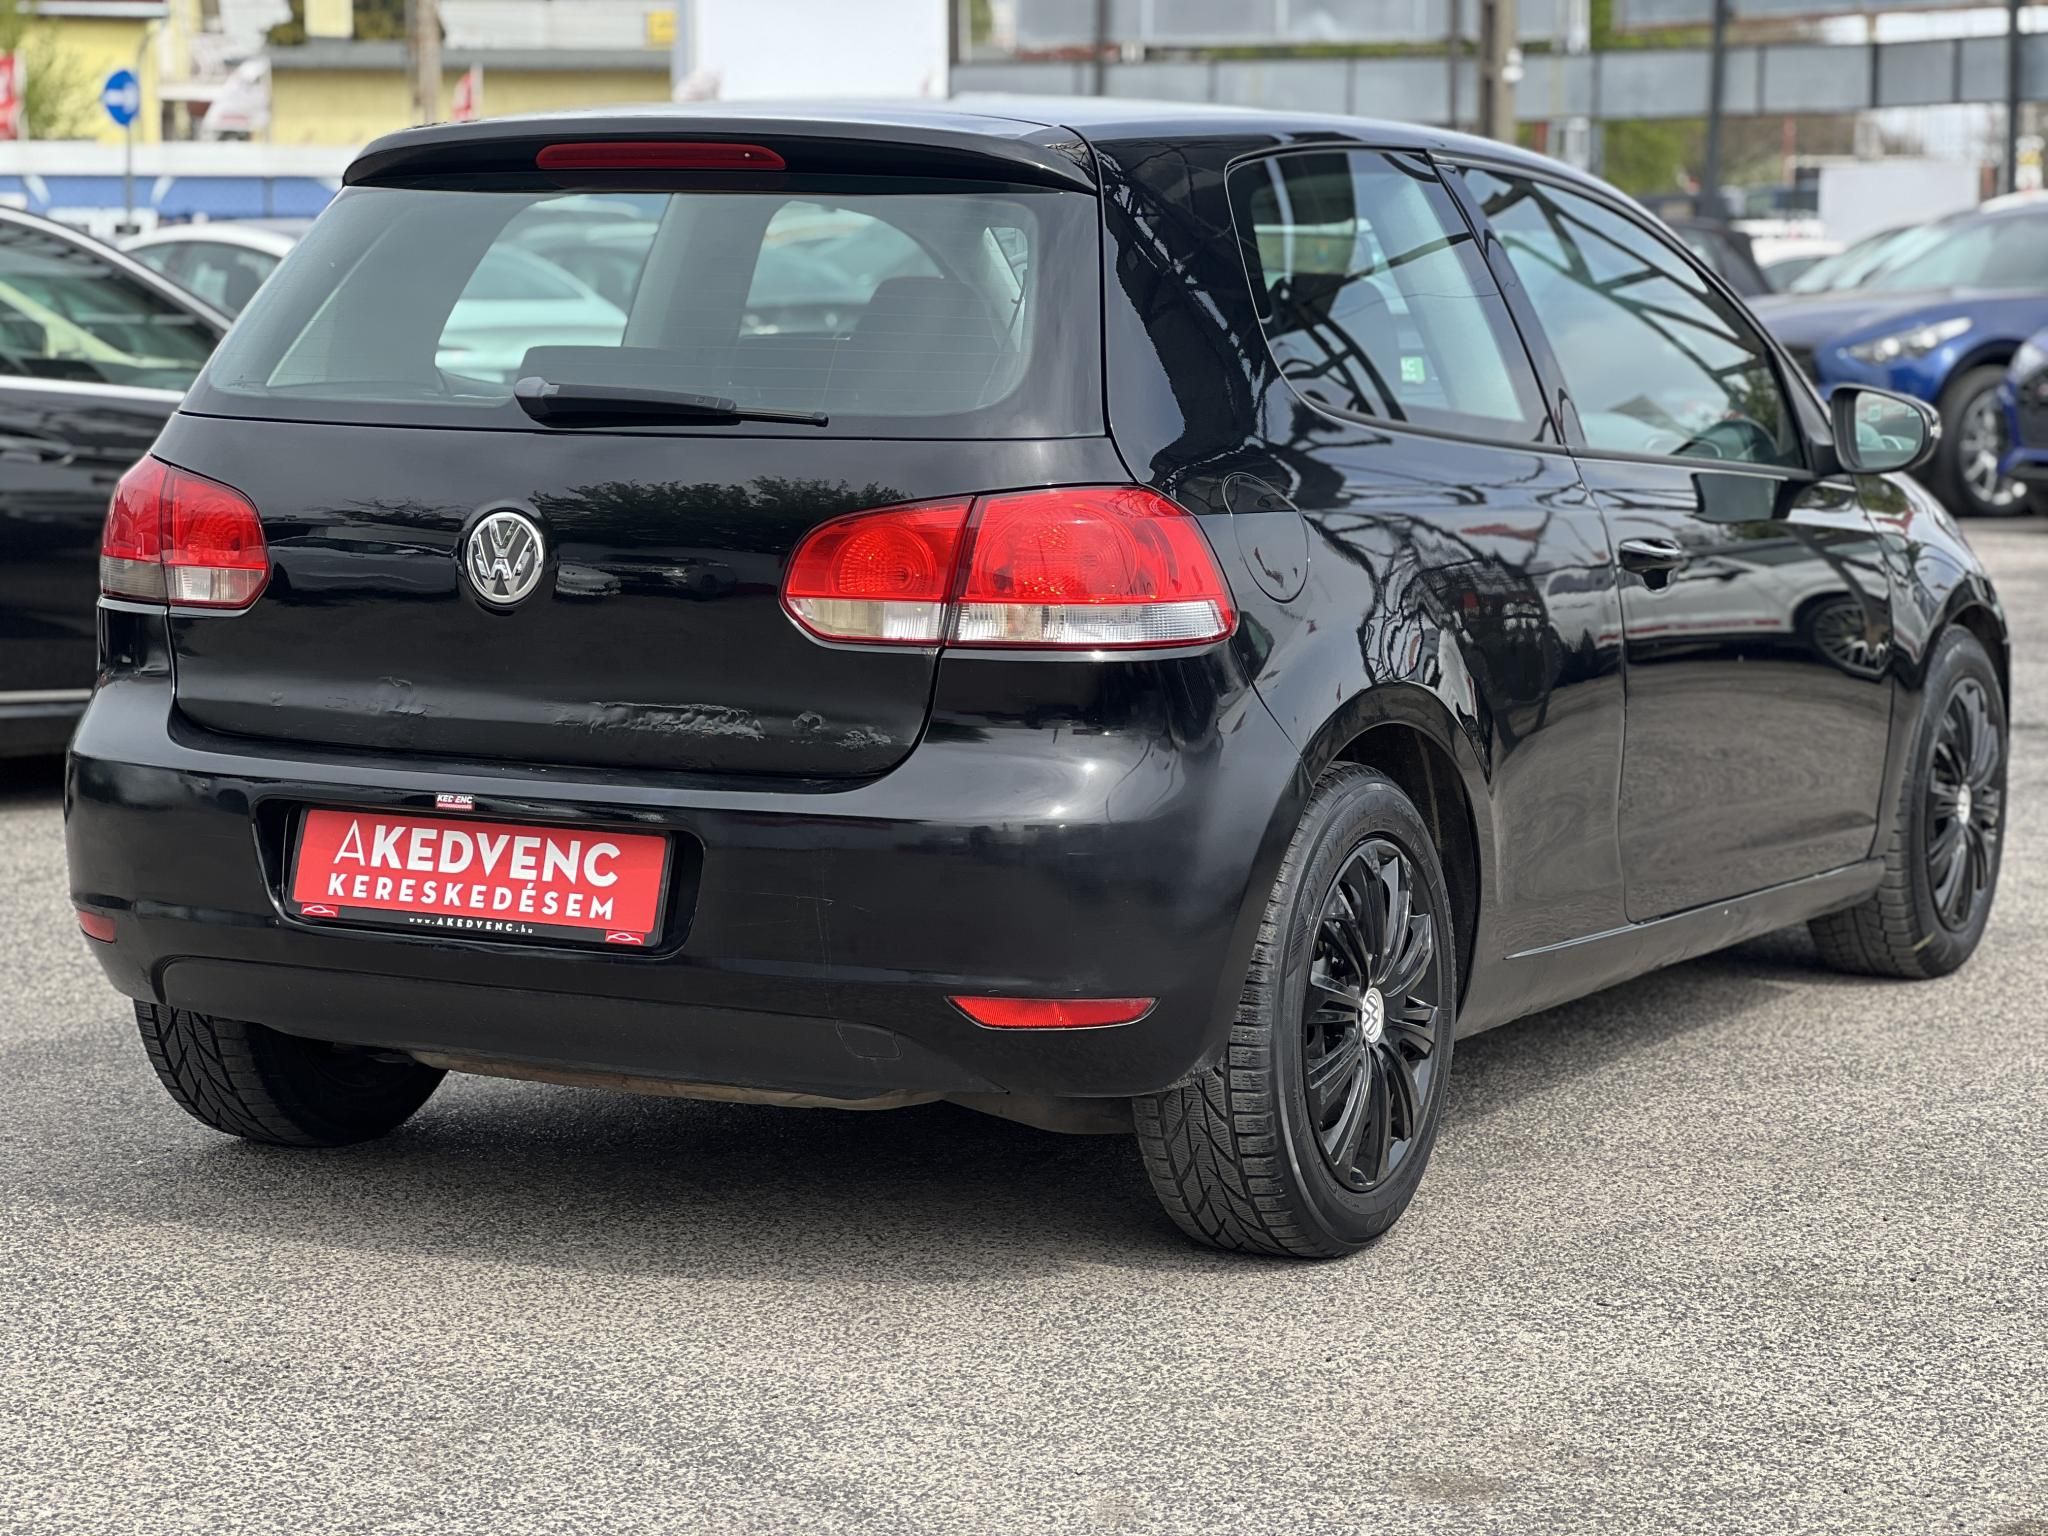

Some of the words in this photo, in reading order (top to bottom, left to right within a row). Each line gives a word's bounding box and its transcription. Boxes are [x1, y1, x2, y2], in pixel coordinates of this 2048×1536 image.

[467, 511, 544, 604] VW
[437, 794, 473, 804] KEDENC
[327, 872, 614, 921] KERESKEDÉSEM
[408, 917, 534, 934] www.AKEDVENC.hu
